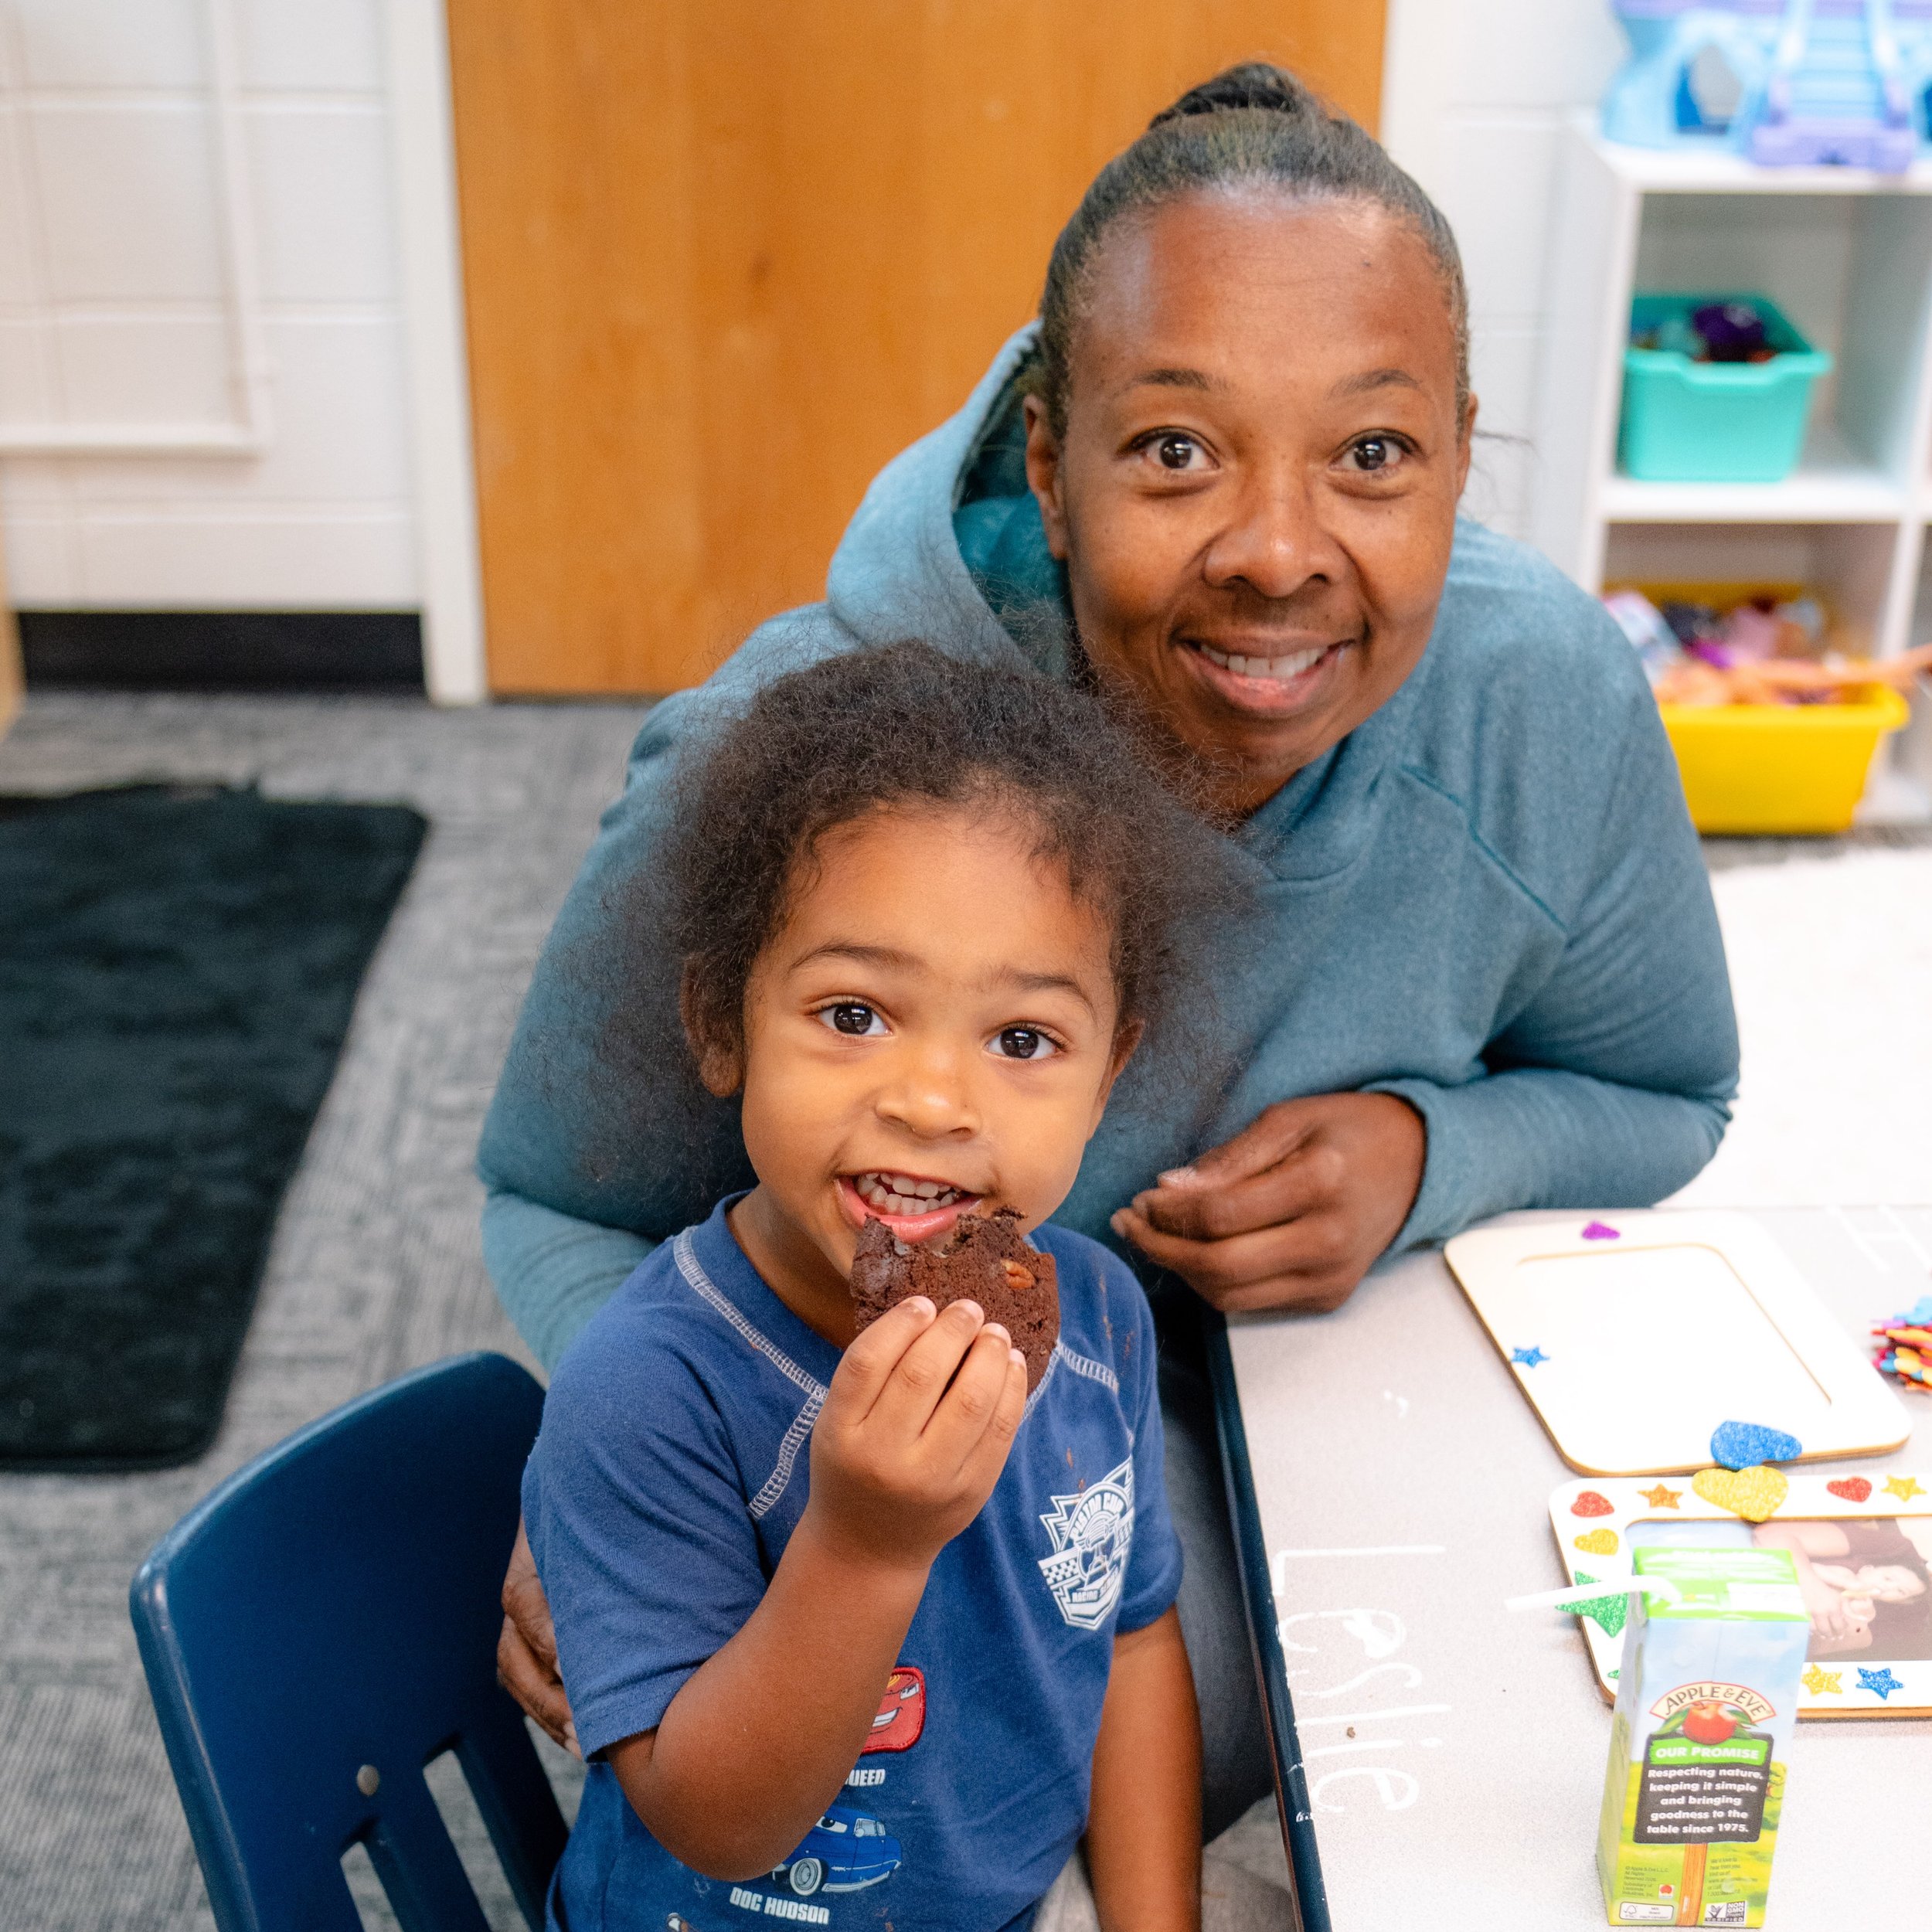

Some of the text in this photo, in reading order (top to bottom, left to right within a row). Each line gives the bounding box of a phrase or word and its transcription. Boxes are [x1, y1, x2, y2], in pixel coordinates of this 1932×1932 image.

[1272, 1544, 1453, 1812] Leslie
[1665, 1685, 1721, 1716] APPLE
[1655, 1747, 1760, 1760] OUR PROMISE
[844, 1768, 886, 1787] UEEN
[1648, 1767, 1716, 1778] Respecting
[1649, 1781, 1757, 1793] keeping it simple
[1660, 1794, 1742, 1806] and bringing
[1650, 1809, 1749, 1821] goodness to the
[1646, 1823, 1749, 1834] table since 1975.
[729, 1886, 830, 1924] DOC HUDSON
